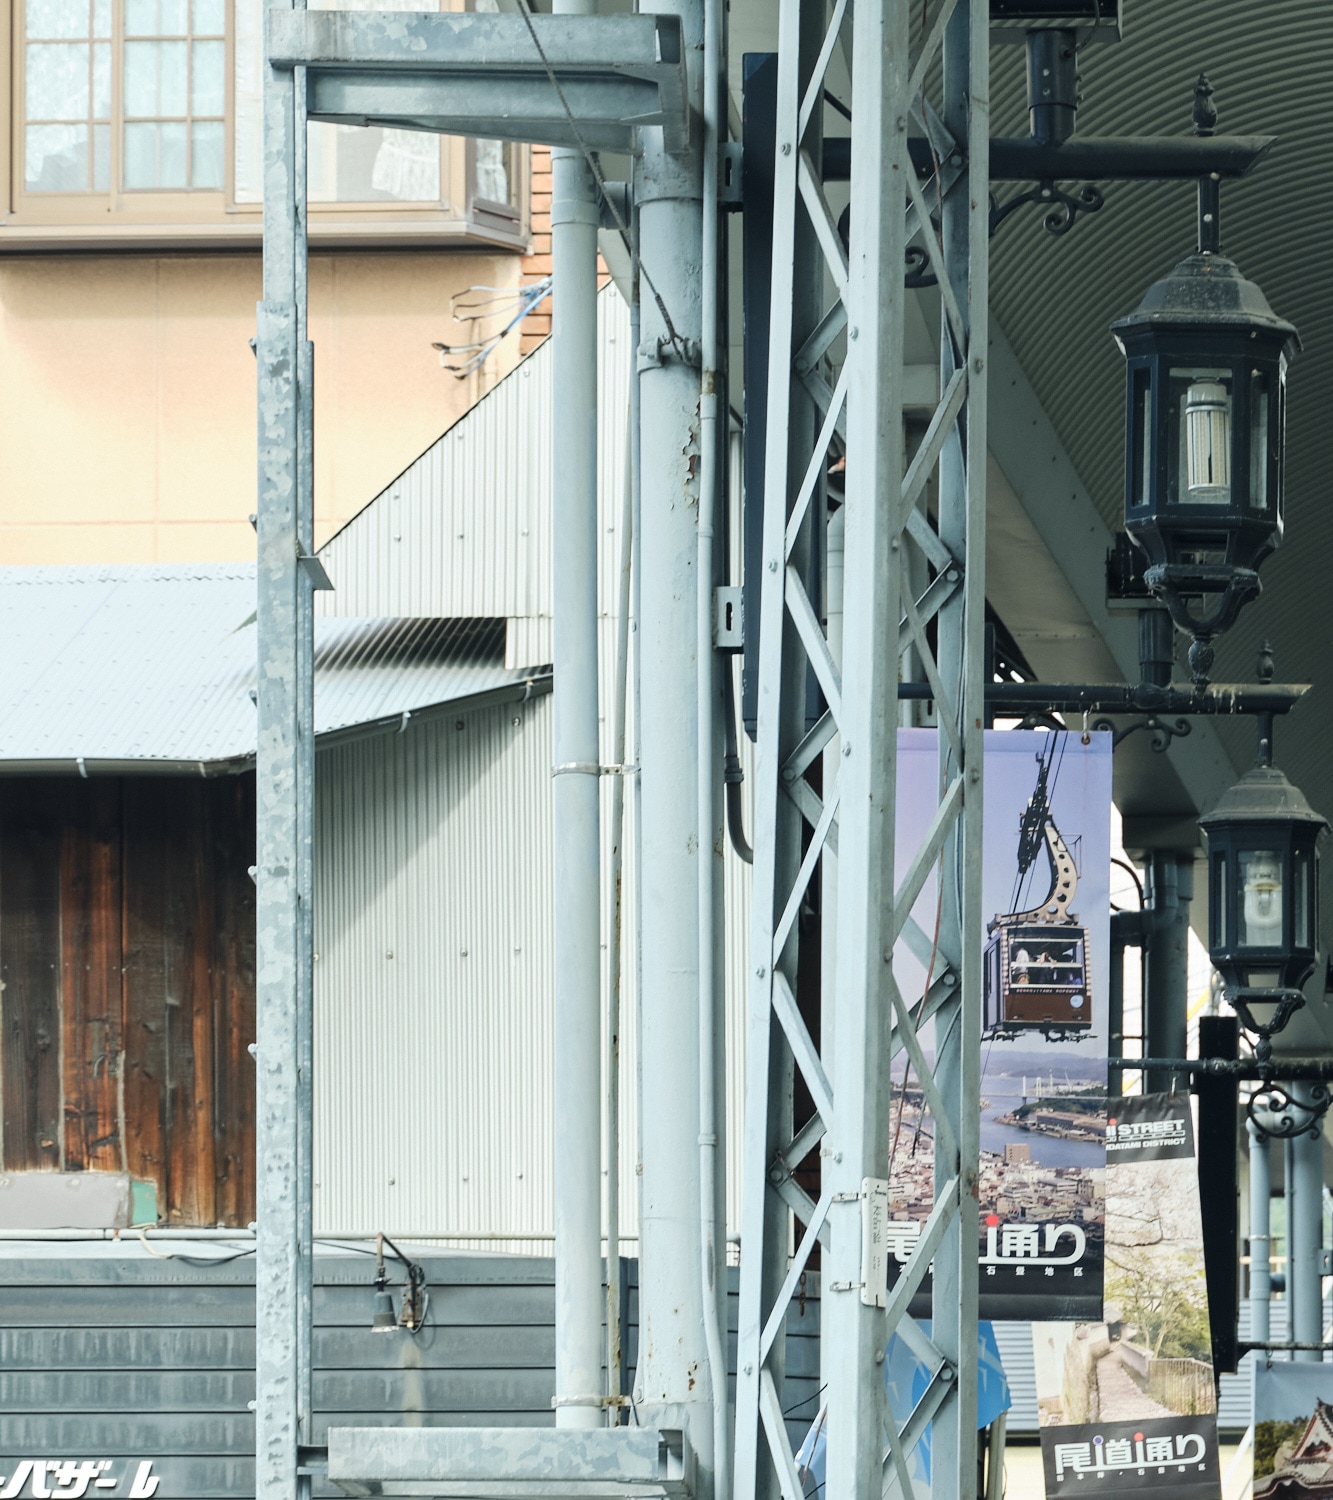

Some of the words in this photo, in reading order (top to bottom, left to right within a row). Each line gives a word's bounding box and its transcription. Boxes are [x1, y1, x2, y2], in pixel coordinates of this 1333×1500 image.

[1117, 1119, 1185, 1136] STREET
[1142, 1137, 1187, 1148] DISTRICT
[1054, 1432, 1206, 1475] 尾道通り
